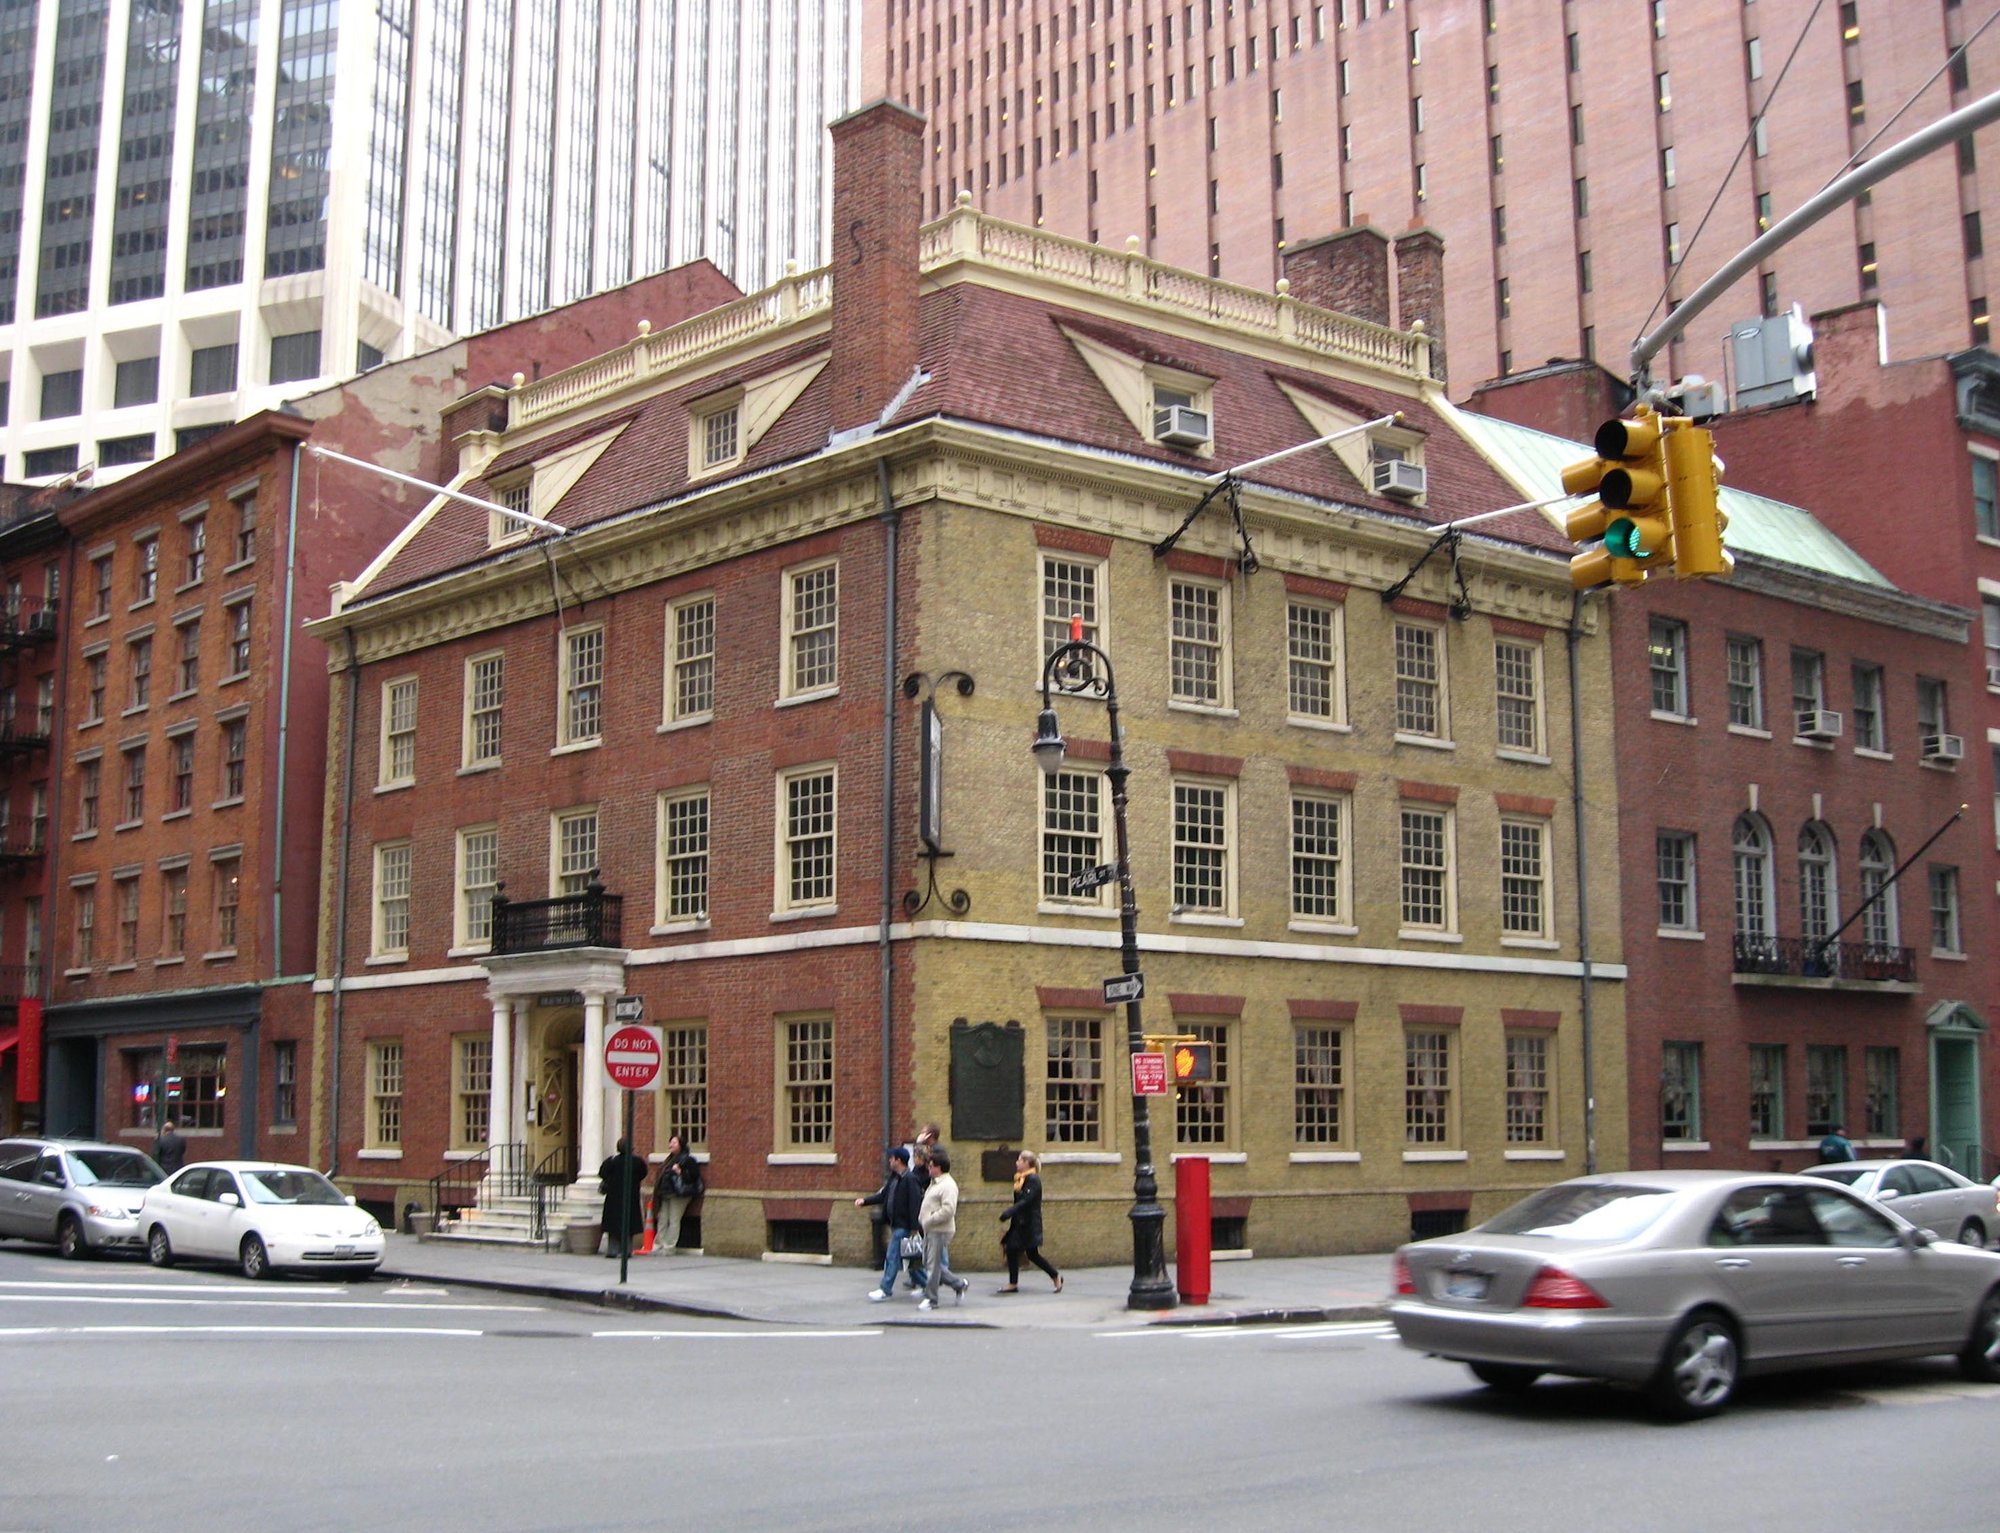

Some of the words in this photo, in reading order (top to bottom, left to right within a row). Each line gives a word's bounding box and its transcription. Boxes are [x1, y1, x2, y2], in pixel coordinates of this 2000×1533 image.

[1071, 870, 1099, 888] PEARL
[614, 1038, 628, 1049] DO
[632, 1039, 653, 1050] NOT
[615, 1066, 650, 1077] ENTER
